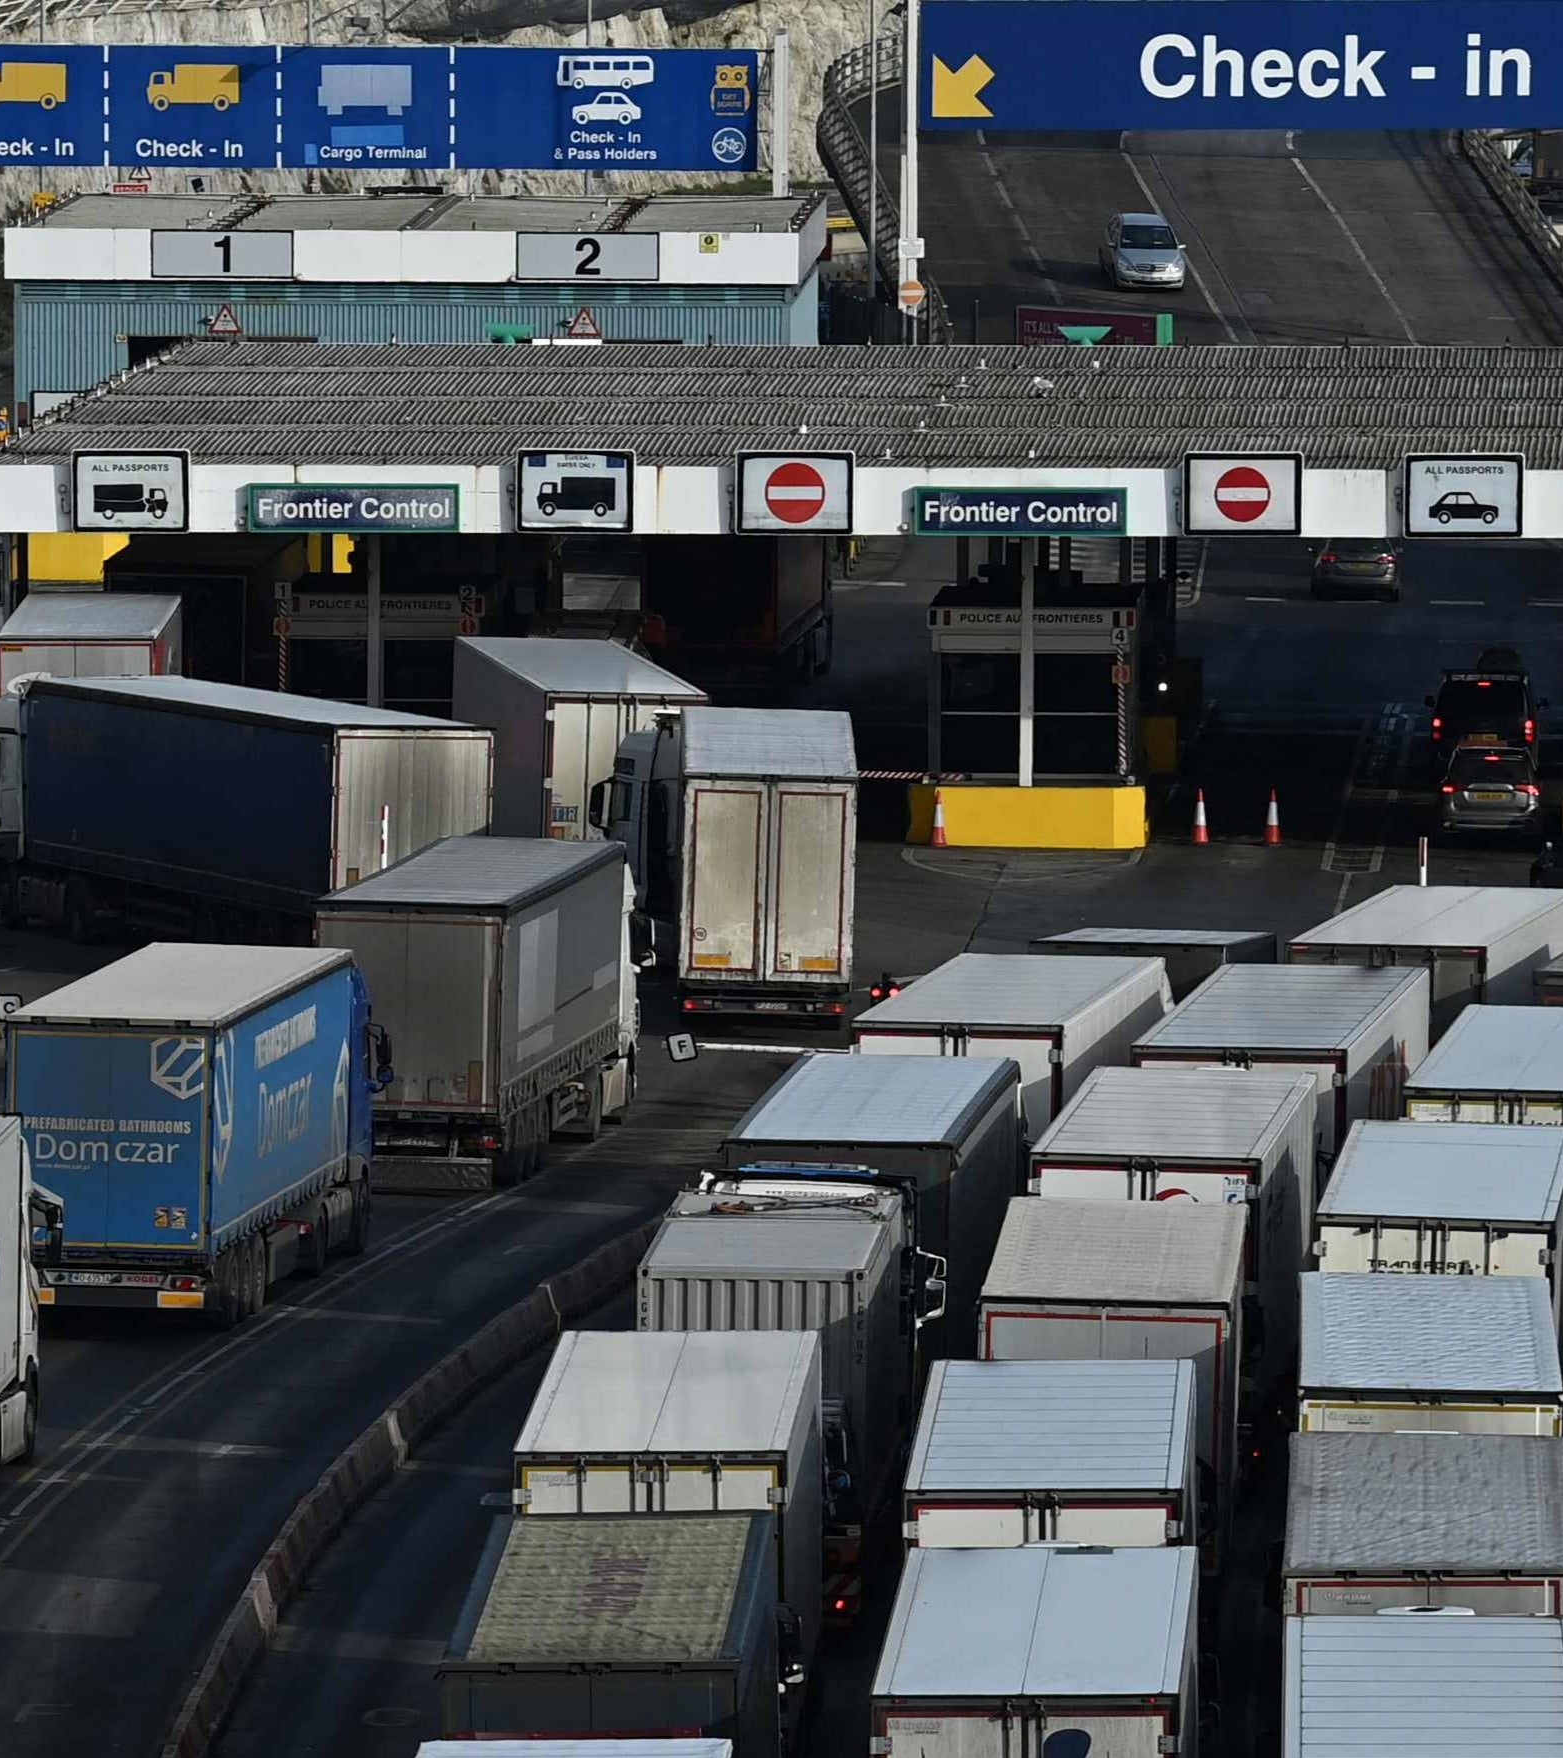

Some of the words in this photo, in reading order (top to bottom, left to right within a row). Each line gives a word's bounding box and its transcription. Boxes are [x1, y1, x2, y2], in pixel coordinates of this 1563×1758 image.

[1139, 33, 1386, 98] Check
[1411, 65, 1435, 78] -
[1466, 33, 1532, 97] in
[570, 130, 613, 144] Check
[628, 131, 641, 144] In
[55, 138, 74, 156] In
[136, 139, 203, 157] Check
[224, 139, 243, 157] In
[320, 146, 363, 163] Cargo
[366, 146, 427, 160] Terminal
[553, 148, 564, 161] &
[567, 148, 601, 161] Pass
[604, 148, 657, 161] Holders
[214, 236, 231, 272] 1
[575, 238, 600, 274] 2
[92, 464, 110, 472] ALL
[112, 464, 169, 472] PASSPORTS
[1425, 466, 1443, 474] ALL
[1446, 466, 1504, 475] PASSPORTS
[258, 498, 352, 519] Frontier
[360, 497, 450, 519] Control
[924, 501, 1020, 522] Frontier
[1028, 501, 1118, 522] Control
[279, 585, 286, 596] 1
[463, 587, 473, 599] 2
[309, 600, 351, 609] POLICE
[380, 600, 452, 610] FRONTIERES
[960, 614, 1002, 623] POLICE
[1004, 614, 1021, 623] AU
[1032, 614, 1103, 623] FRONTIERES
[1115, 630, 1124, 641] 4
[4, 1002, 15, 1014] C
[678, 1040, 687, 1053] F
[24, 1116, 115, 1133] PREFABRICATED
[119, 1119, 191, 1135] BATHROOMS
